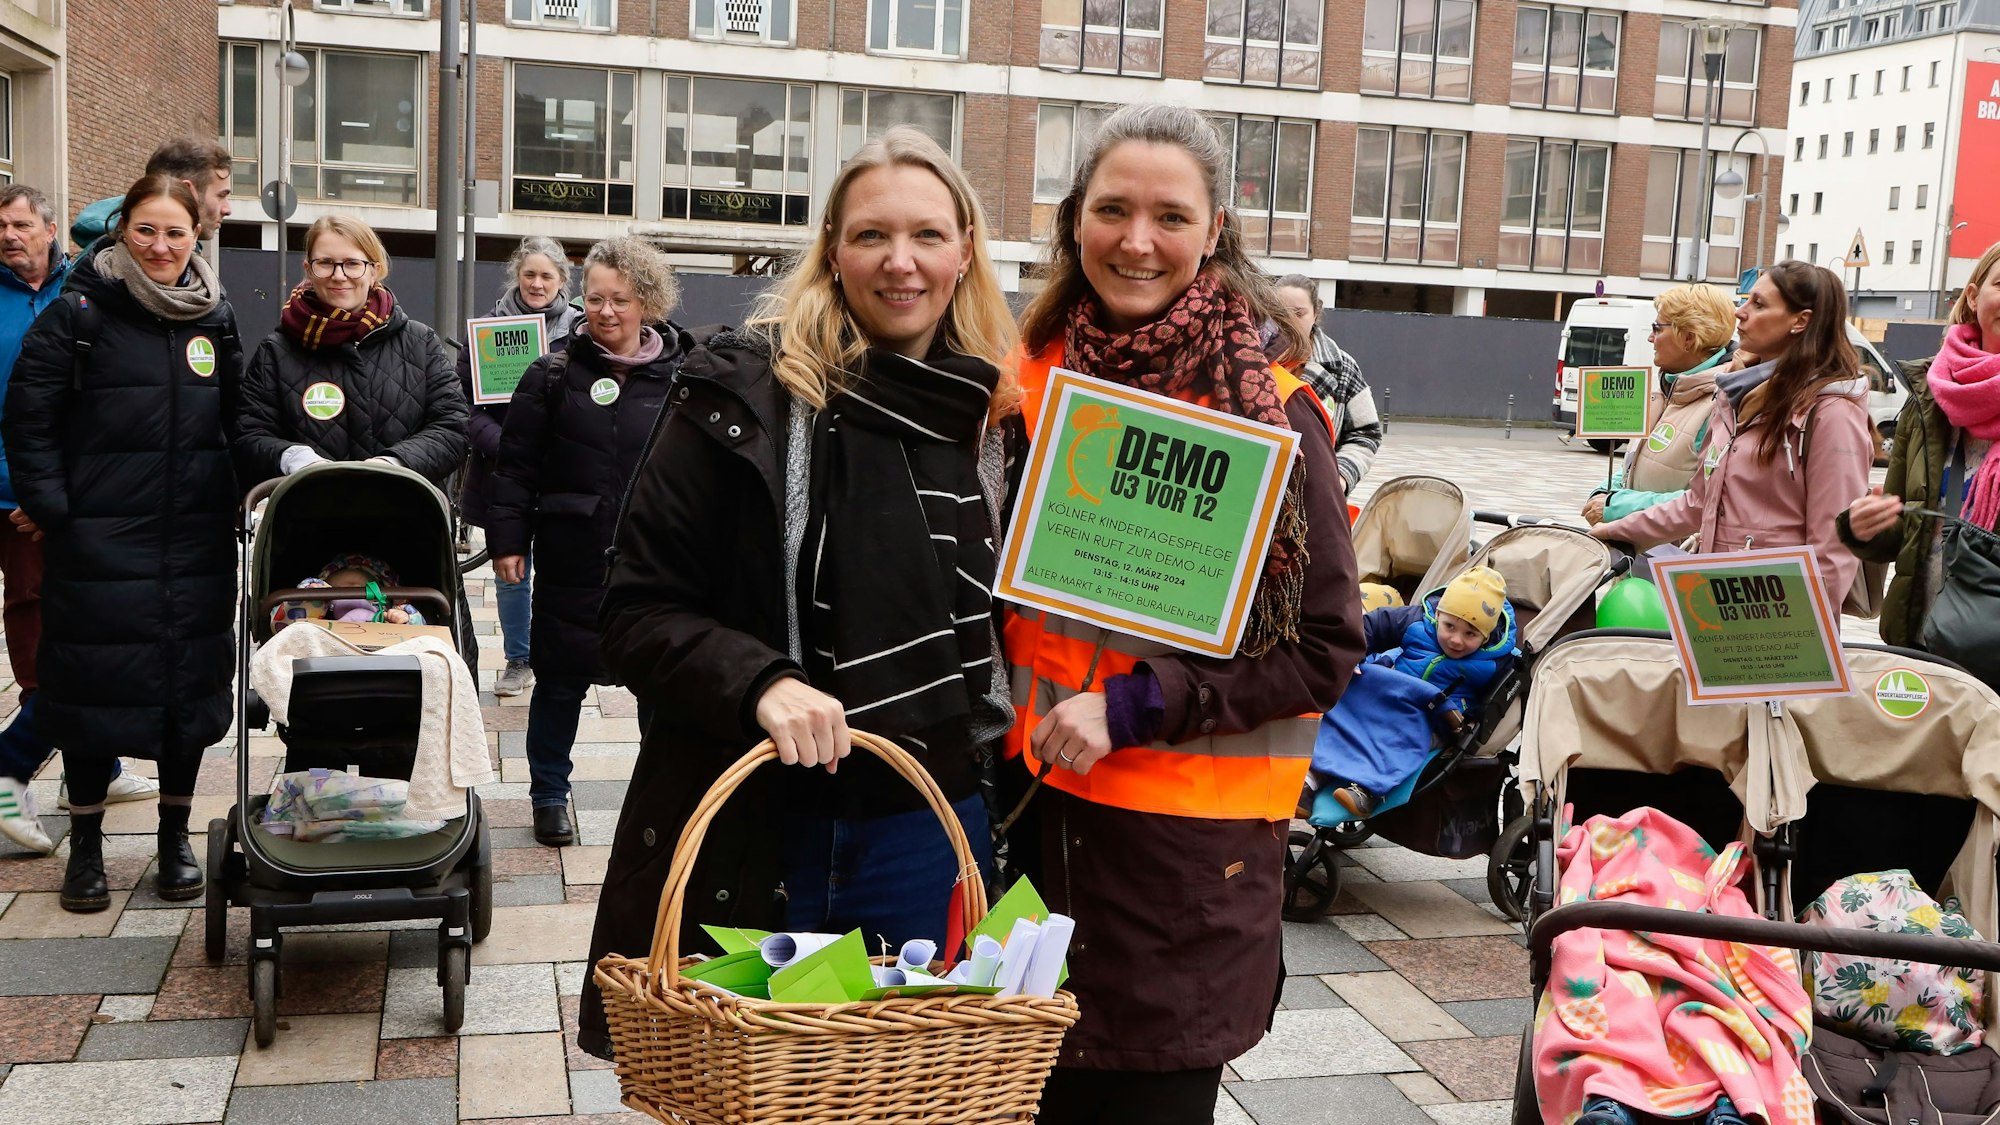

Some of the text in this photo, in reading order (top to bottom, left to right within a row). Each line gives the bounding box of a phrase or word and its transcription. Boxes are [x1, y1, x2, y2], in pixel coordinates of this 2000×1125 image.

[521, 182, 596, 198] SENATOR
[700, 193, 771, 208] SENATOR
[494, 330, 528, 347] DEMO
[496, 346, 529, 356] U3 VOR 12
[1602, 376, 1634, 390] DEMO
[1602, 390, 1634, 398] U3 VOR 12
[1116, 425, 1230, 494] DEMO
[1110, 470, 1218, 522] U3 VOR 12
[1048, 500, 1232, 562] KÖLNER KINDERTAGESPFLEGE
[1046, 520, 1225, 580] VEREIN RUFT ZUR DEMO AUF
[1074, 549, 1186, 586] DIENSTAG, 12. MÄRZ 2024
[1093, 567, 1112, 580] 13:15
[1119, 574, 1140, 587] 14:15
[1141, 580, 1160, 593] UHR
[1710, 574, 1786, 606] DEMO
[1027, 566, 1218, 628] ALTER MARKT & THEO BURAUEN PLATZ
[1718, 602, 1792, 622] U3 VOR 12
[1726, 630, 1816, 641] KINDERTAGESPFLEGE
[1714, 642, 1800, 654] RUFT ZUR DEMO AUF
